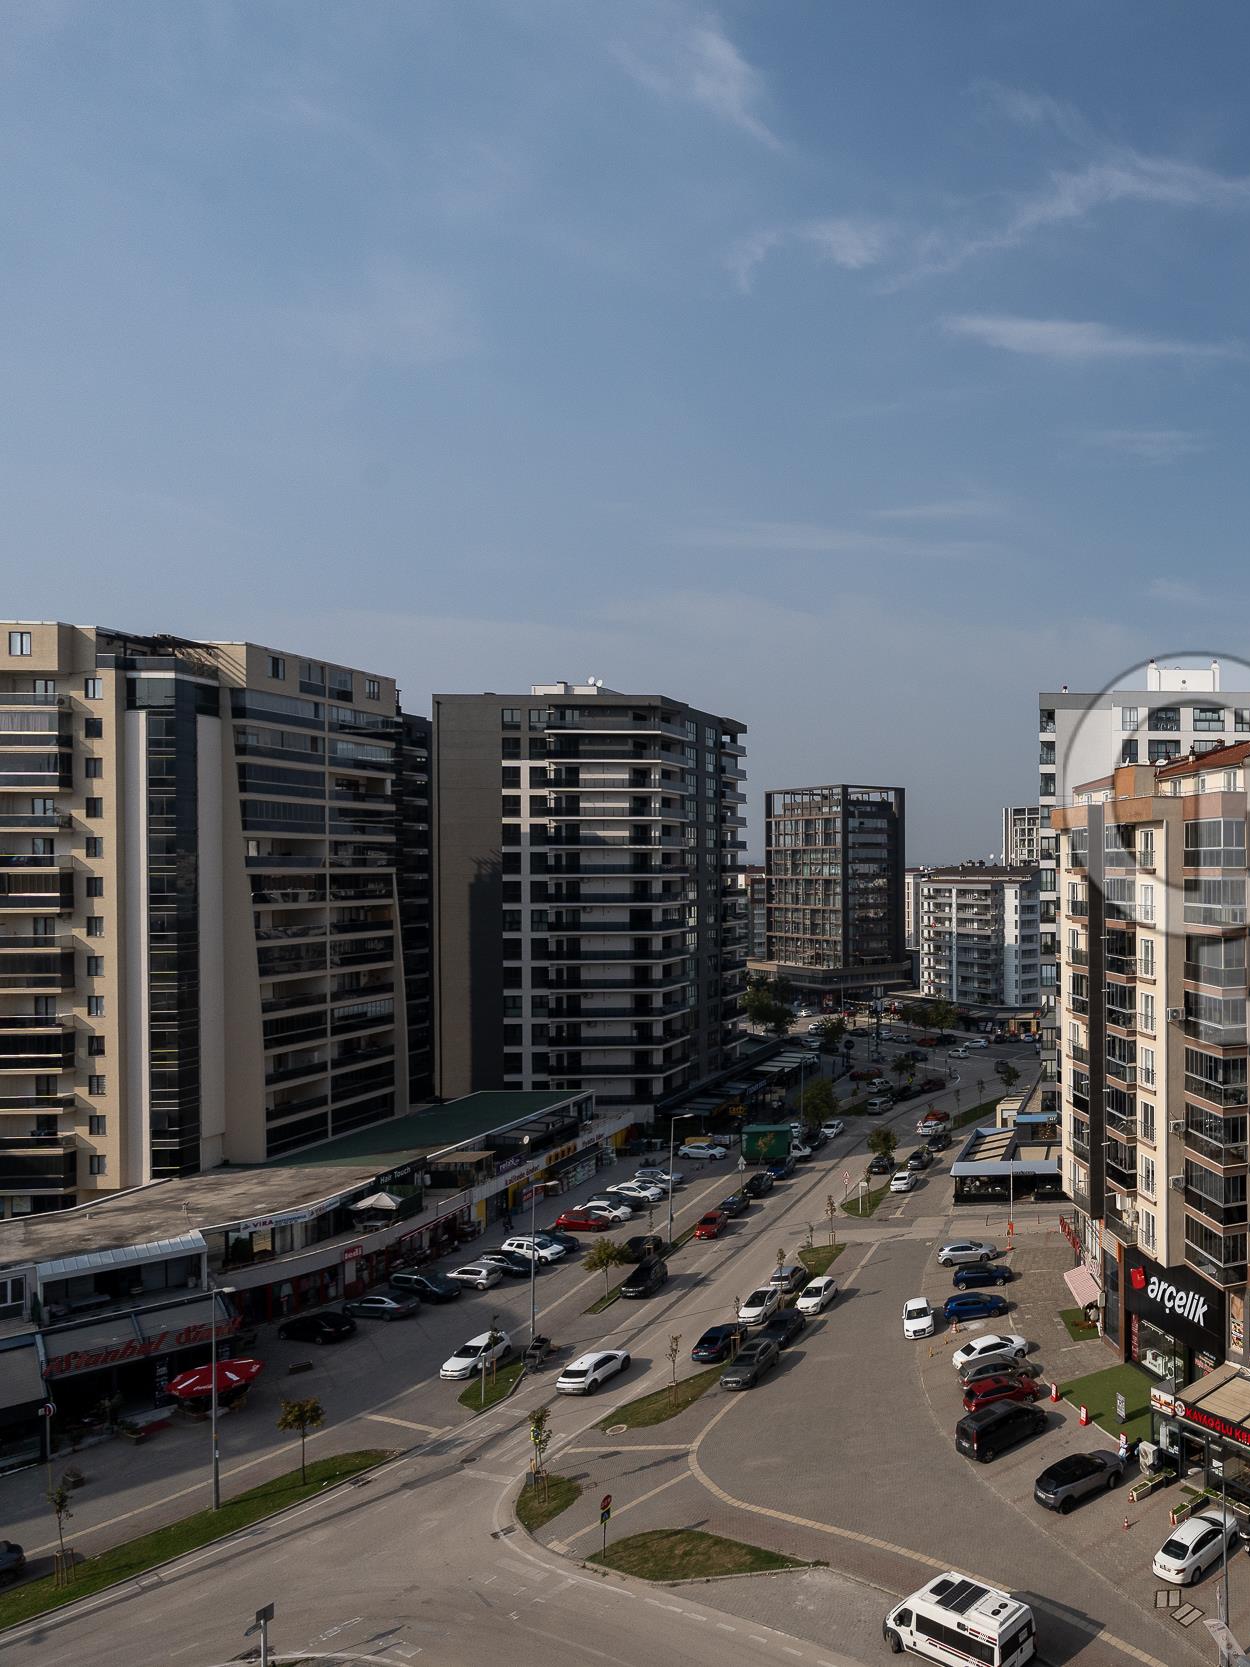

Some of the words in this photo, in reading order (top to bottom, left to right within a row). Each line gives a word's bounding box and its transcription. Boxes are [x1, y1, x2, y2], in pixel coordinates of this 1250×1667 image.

[379, 1174, 392, 1185] Hair
[394, 1166, 411, 1179] Touch
[1147, 1275, 1209, 1328] arçelik
[1185, 1407, 1233, 1437] KAYAOĞLU
